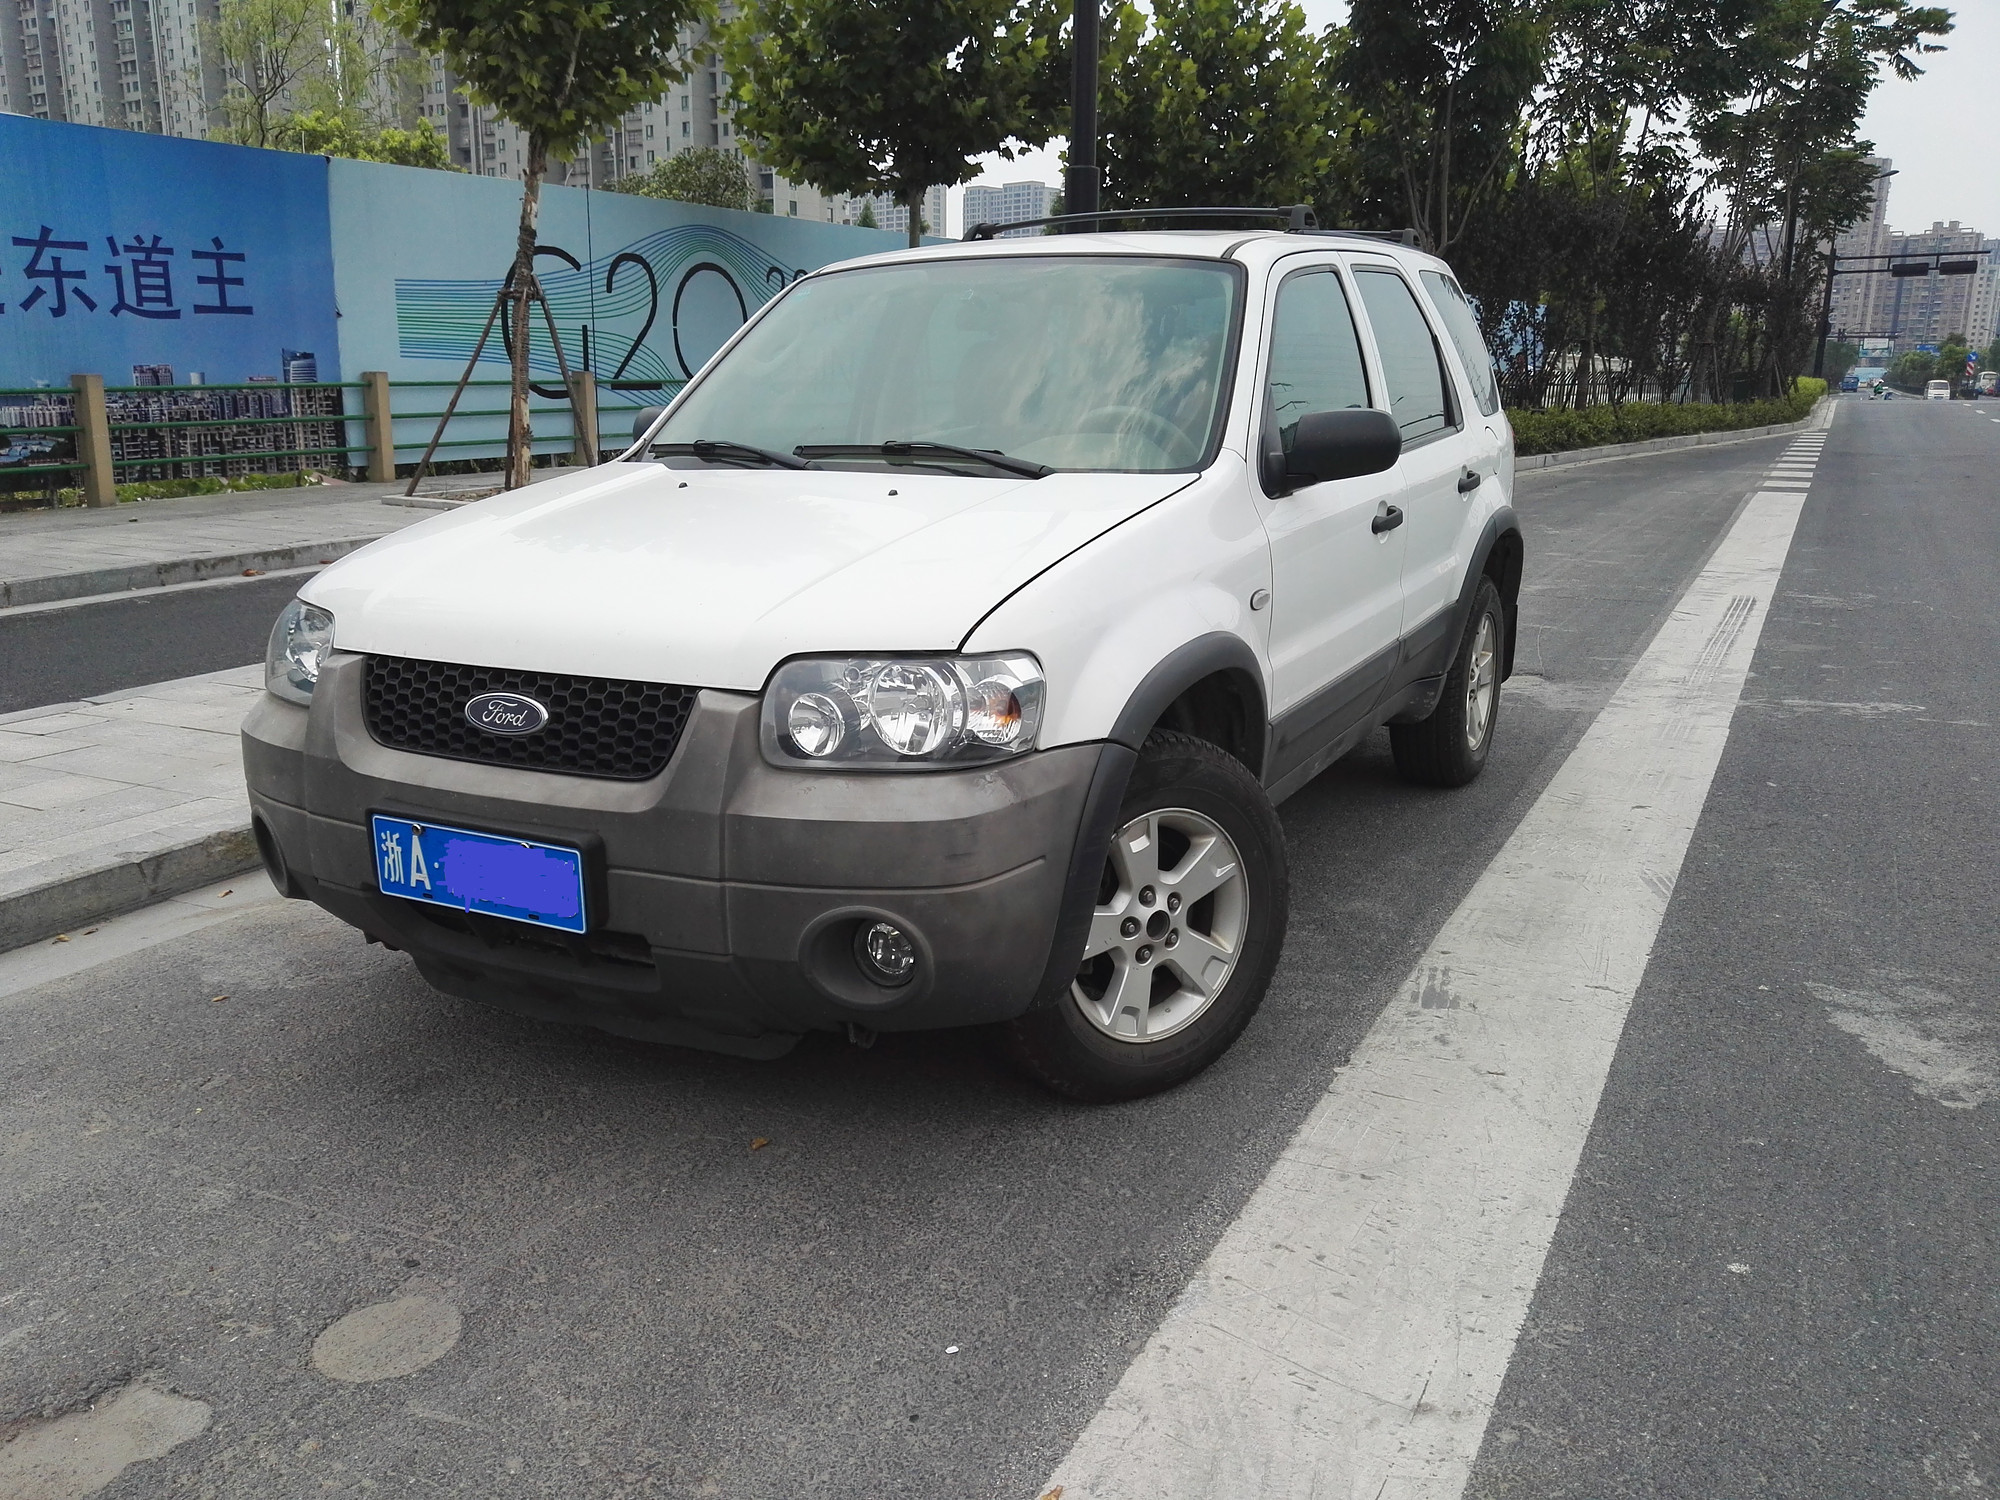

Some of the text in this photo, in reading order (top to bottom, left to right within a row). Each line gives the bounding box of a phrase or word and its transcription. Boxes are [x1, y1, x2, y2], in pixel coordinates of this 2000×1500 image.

[0, 225, 254, 319] 东道主
[482, 700, 528, 727] Ford
